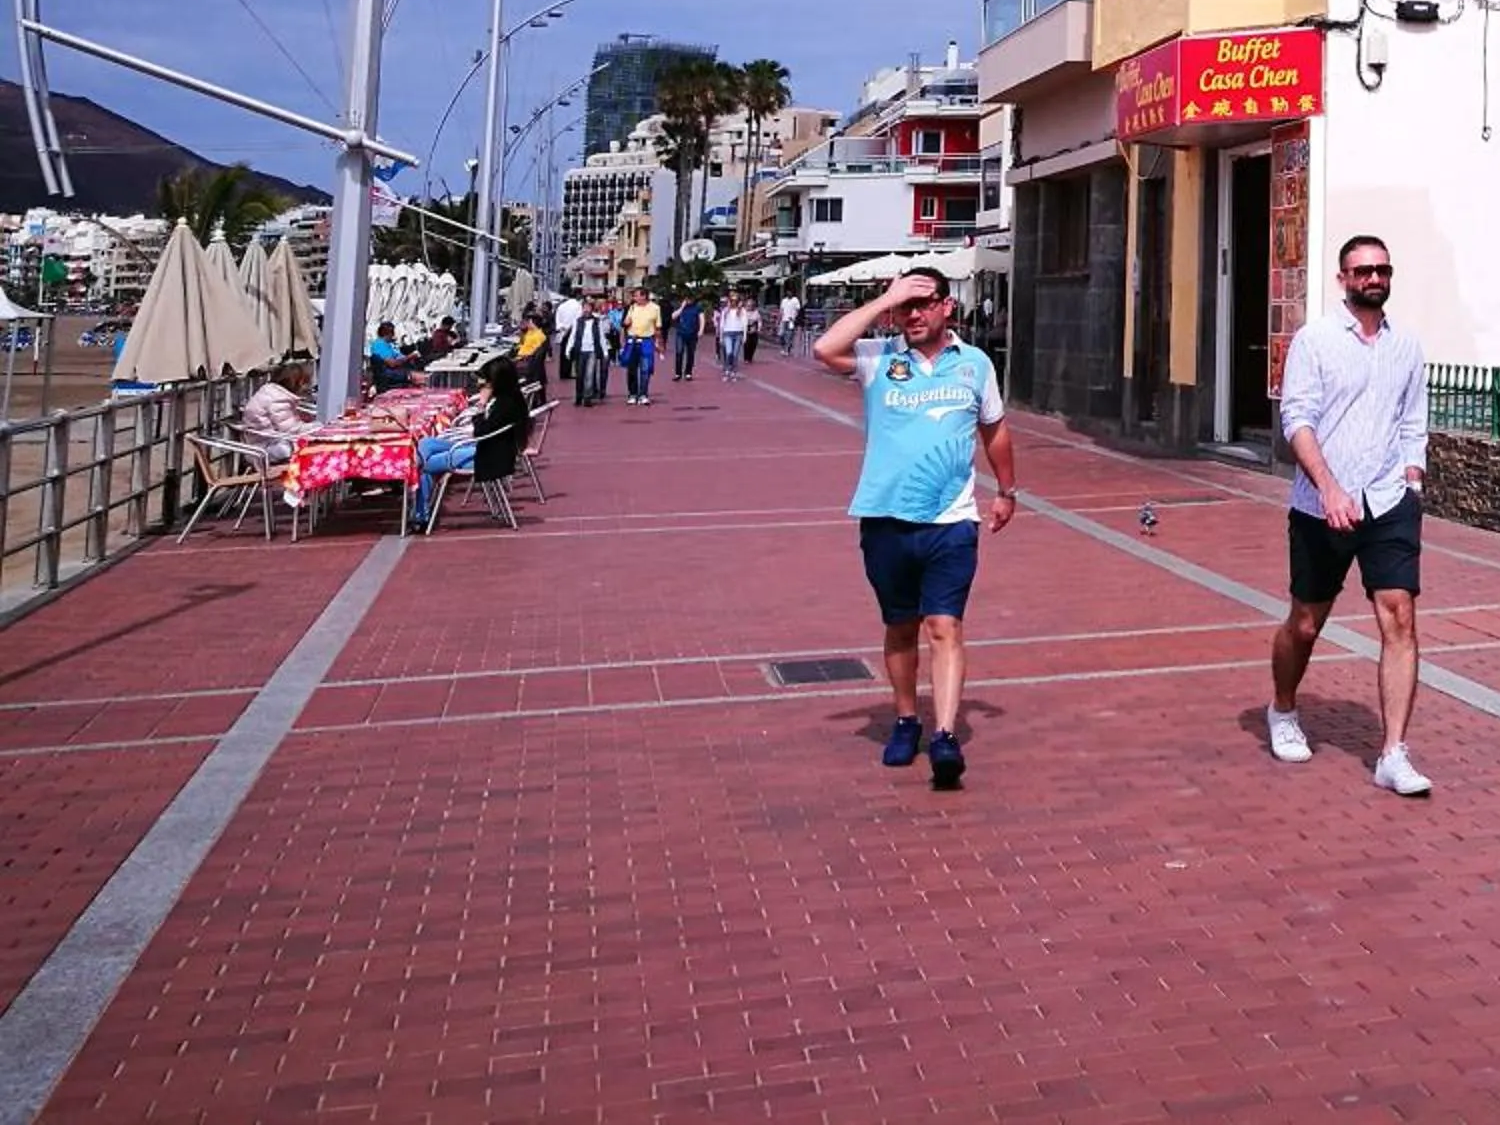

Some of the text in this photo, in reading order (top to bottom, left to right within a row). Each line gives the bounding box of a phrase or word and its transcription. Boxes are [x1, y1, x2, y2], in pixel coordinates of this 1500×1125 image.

[1217, 36, 1281, 63] Buffet
[1199, 65, 1299, 92] Casa Chen
